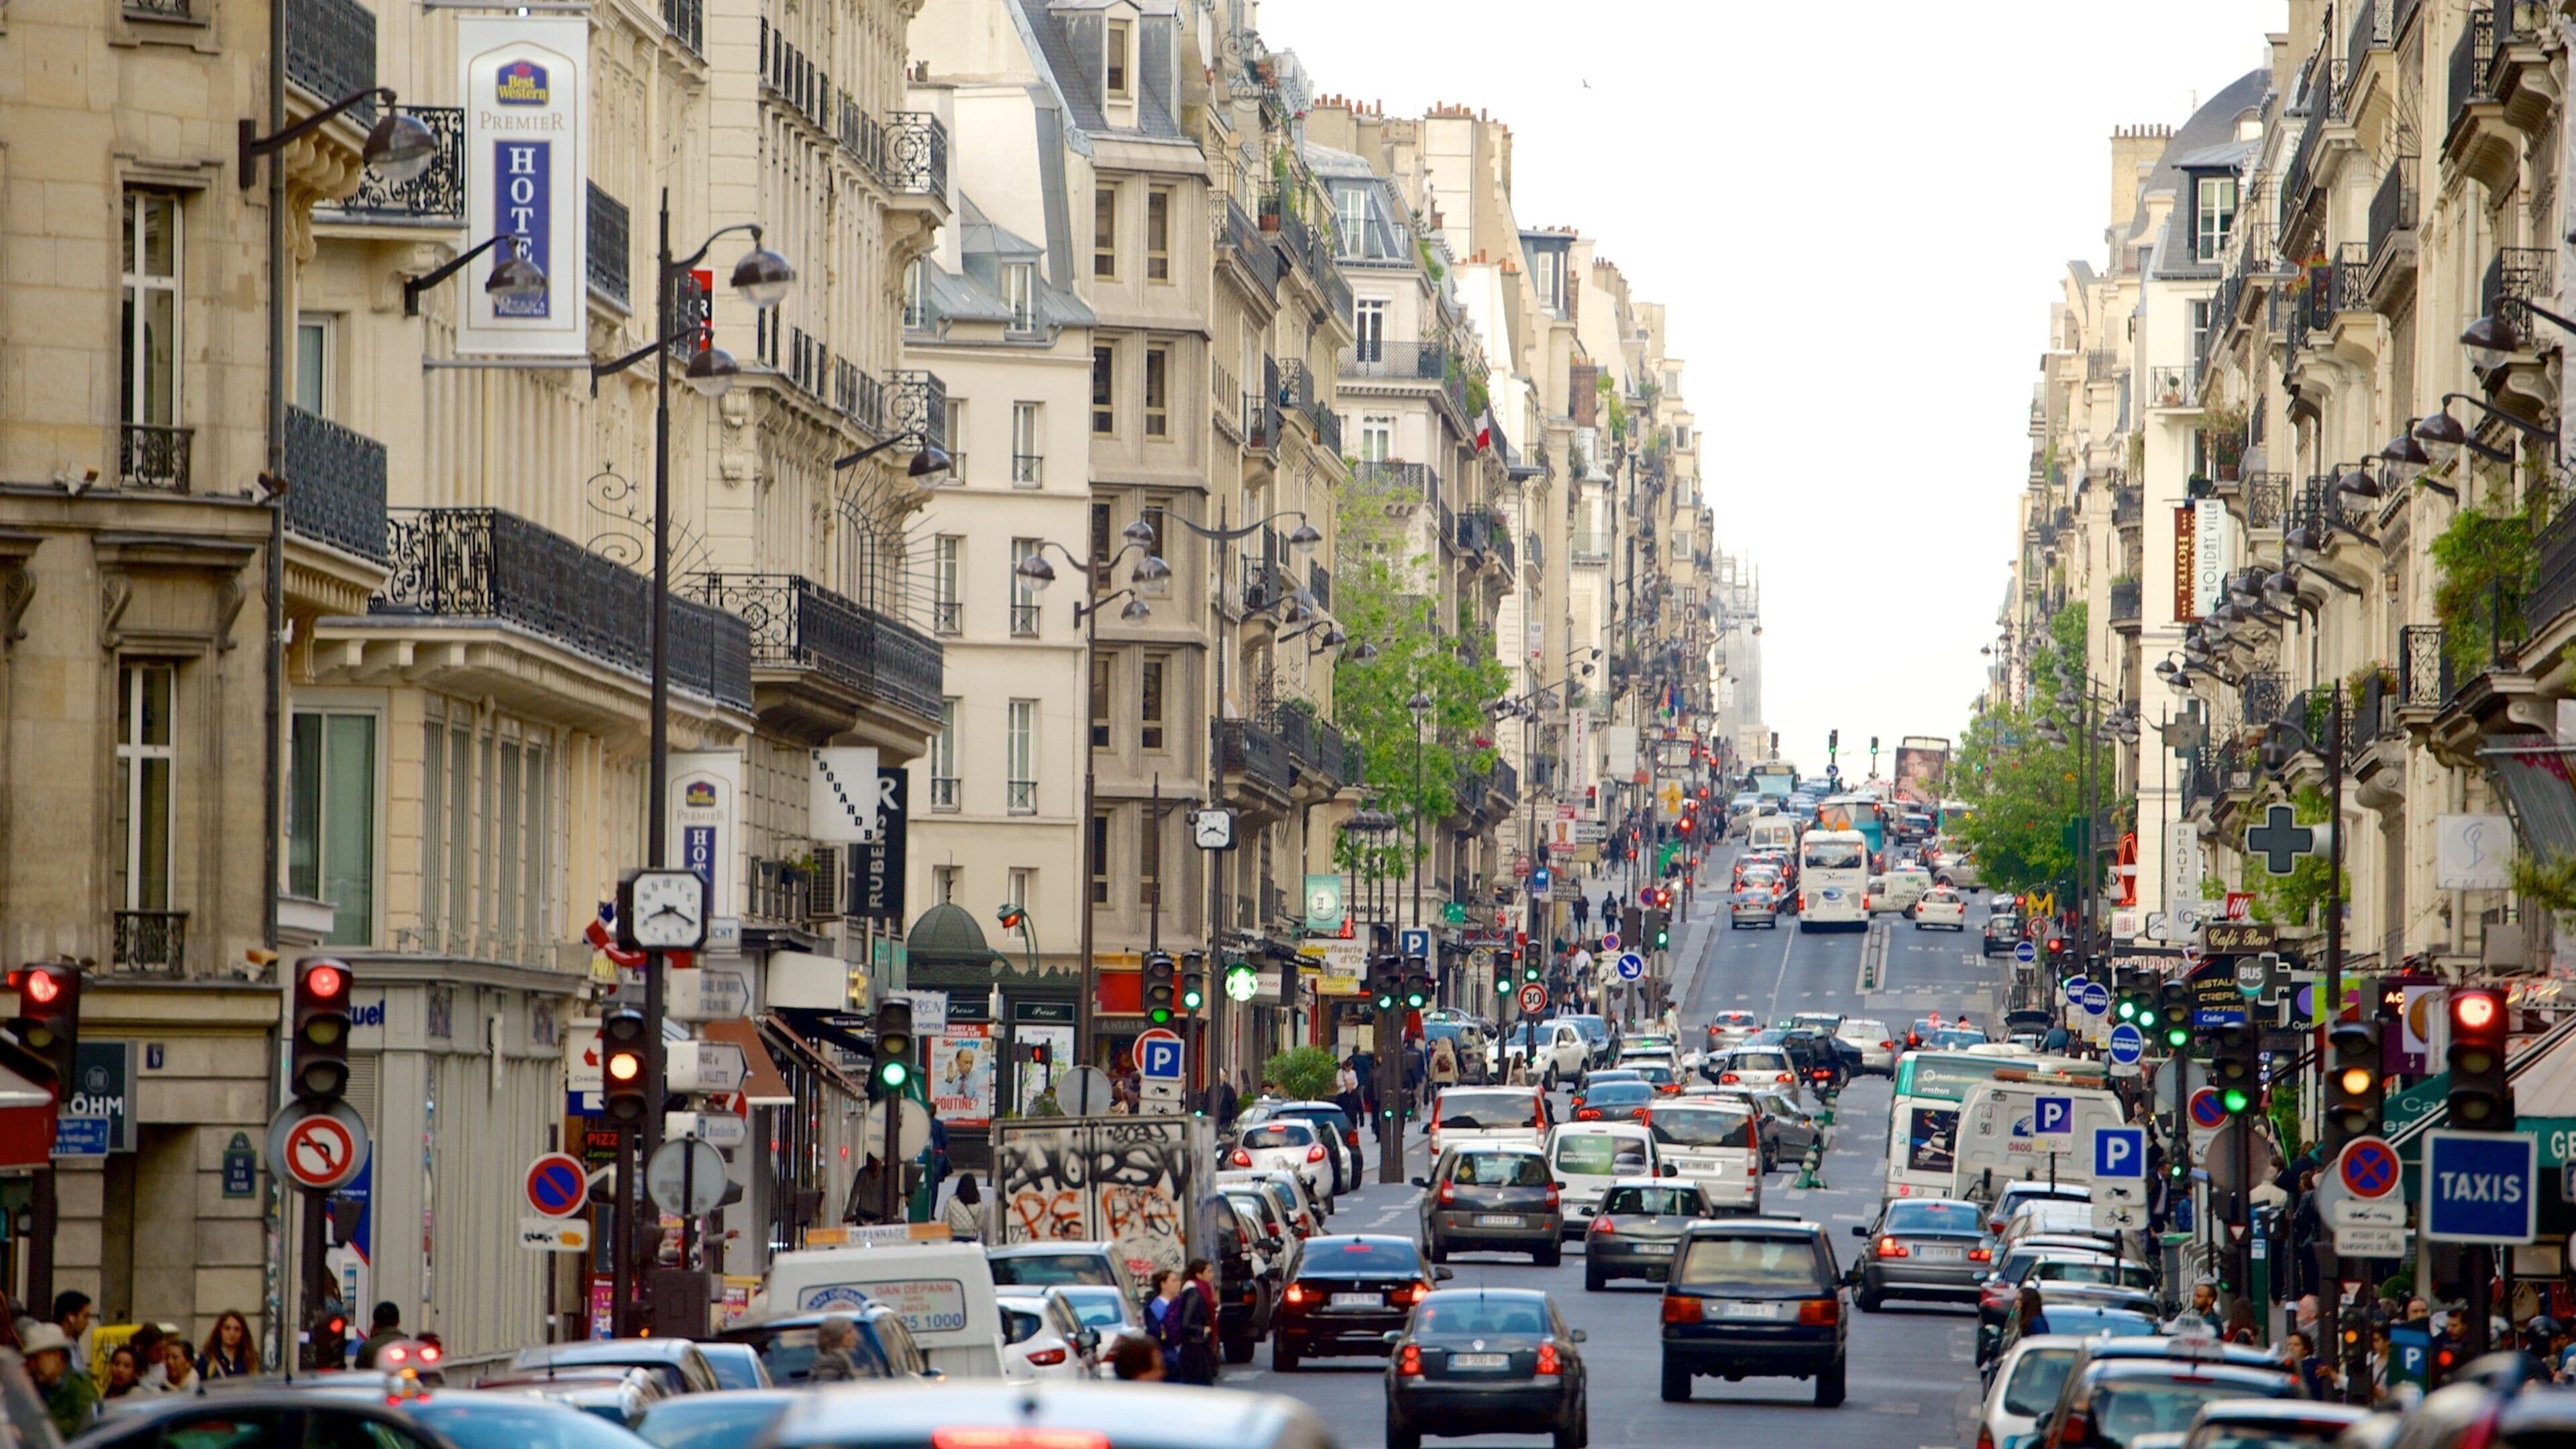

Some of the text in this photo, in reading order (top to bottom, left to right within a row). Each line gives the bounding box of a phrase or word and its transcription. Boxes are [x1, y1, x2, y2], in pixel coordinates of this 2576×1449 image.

[508, 75, 535, 89] Best
[498, 86, 546, 101] Western
[480, 111, 565, 130] PREMIER
[508, 147, 536, 264] HOTE
[2178, 535, 2189, 597] HOTEL
[1686, 590, 1696, 675] HOTEL
[812, 750, 863, 826] EDOUARD
[677, 809, 725, 822] PREMIER
[869, 814, 888, 908] RUBENS
[2027, 892, 2054, 917] M
[1409, 934, 1422, 953] P
[2208, 928, 2271, 953] Café Bar
[2239, 967, 2263, 980] BUS
[1524, 990, 1540, 1005] 30
[349, 1000, 385, 1026] uel
[1032, 1007, 1058, 1016] Presse
[2202, 1014, 2225, 1022] Cadet
[943, 1039, 980, 1050] Society
[1154, 1046, 1172, 1071] P
[934, 1096, 979, 1112] POUTINE?
[2045, 1104, 2063, 1128] P
[1980, 1122, 1991, 1135] 90
[587, 1133, 618, 1146] PIZZ
[2008, 1142, 2032, 1153] 0800
[2106, 1137, 2130, 1170] P
[1893, 1165, 1902, 1177] 70
[2439, 1171, 2522, 1204] TAXIS
[874, 1284, 900, 1296] DAN
[926, 1313, 962, 1328] 1000
[2405, 1347, 2420, 1369] P
